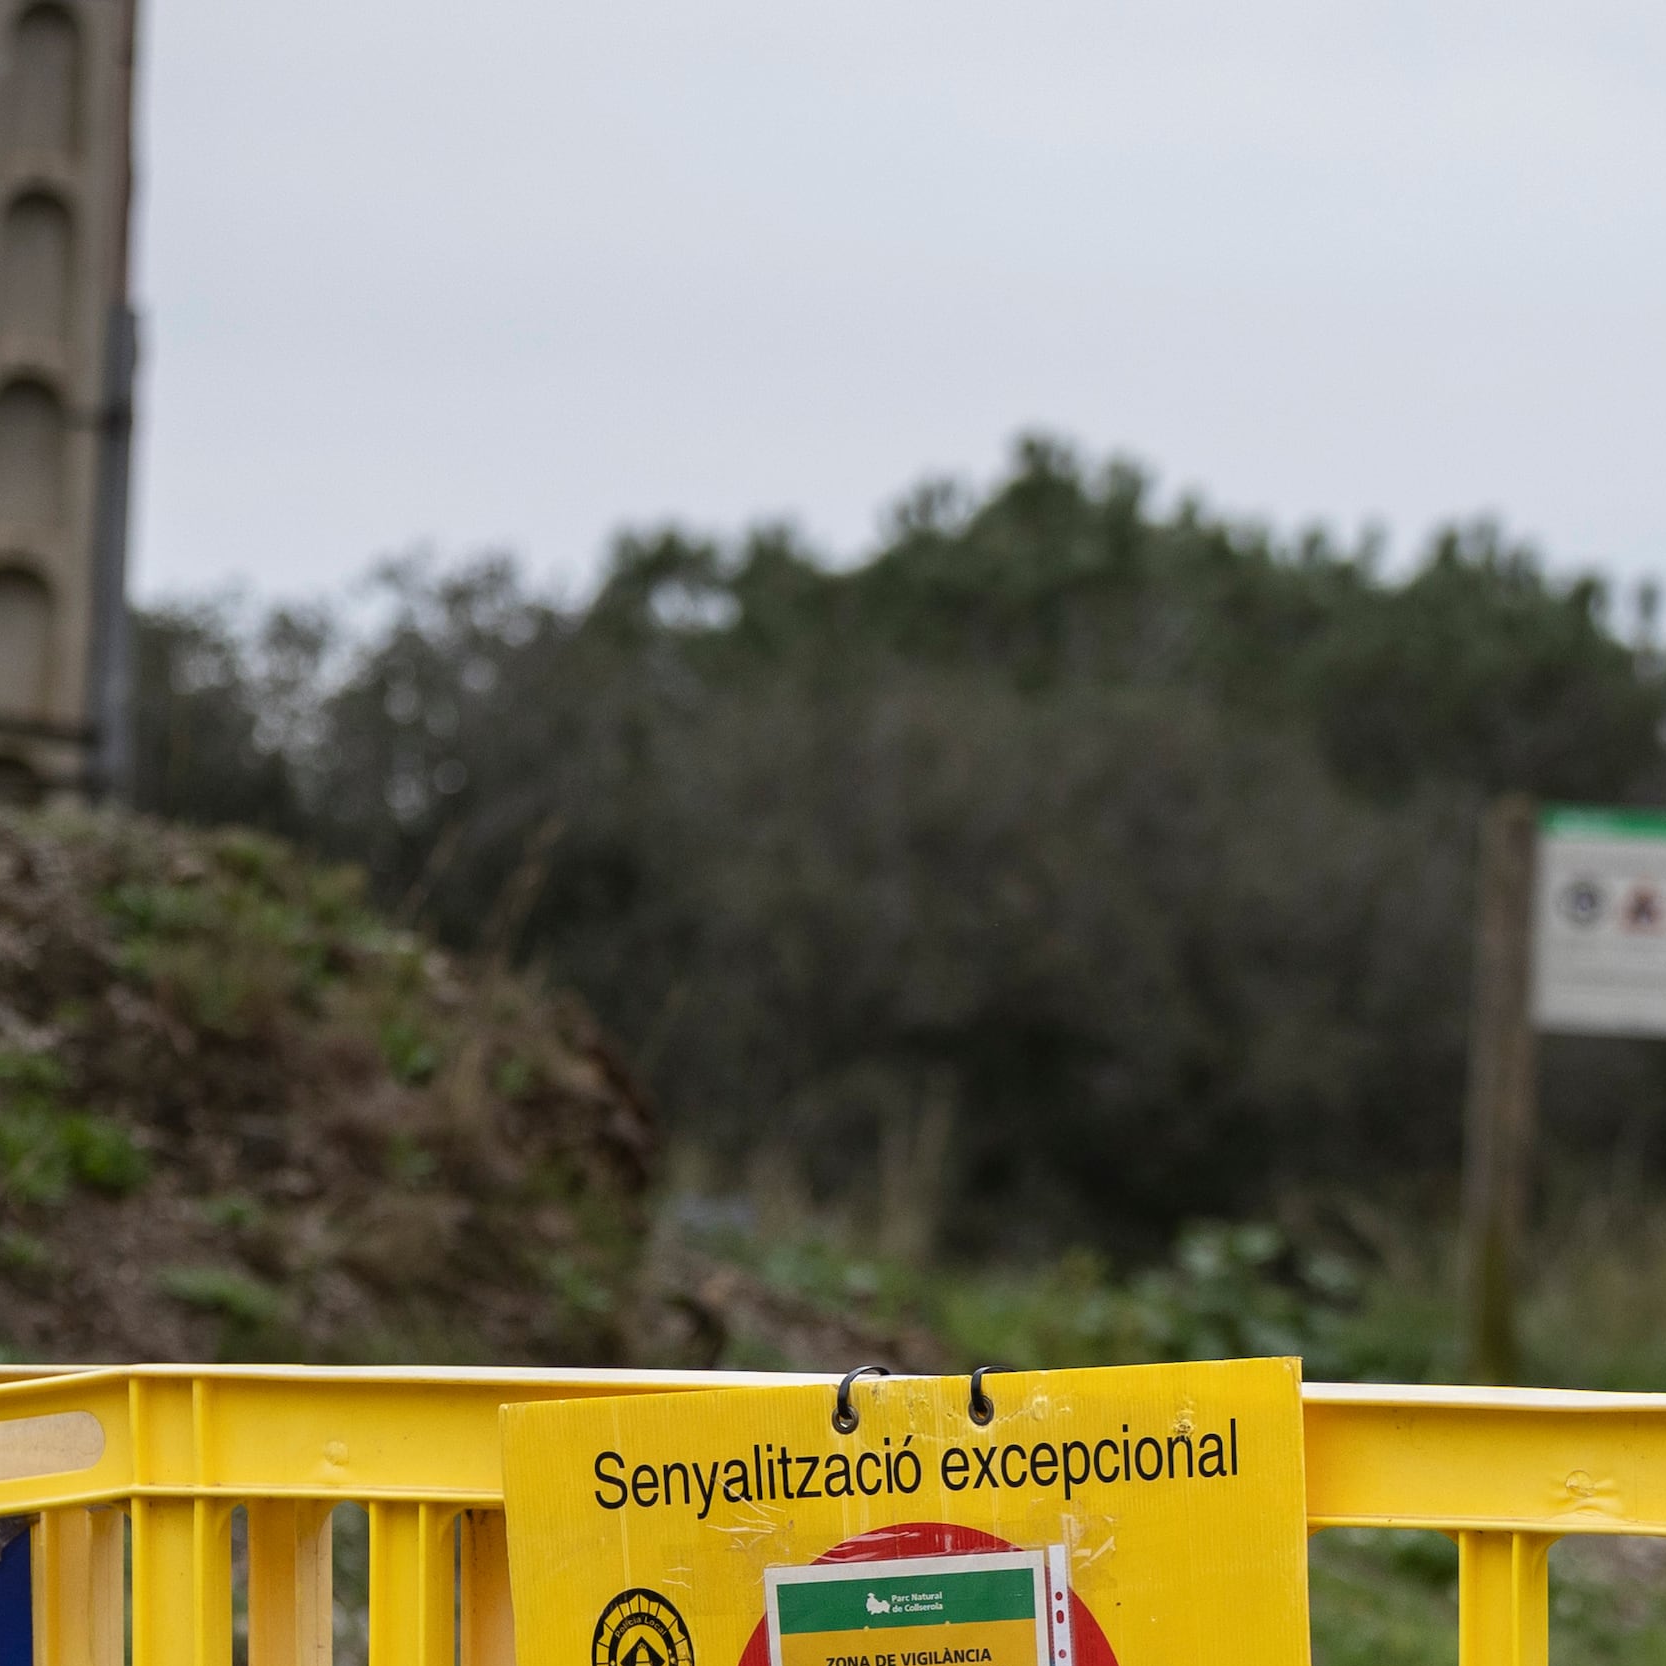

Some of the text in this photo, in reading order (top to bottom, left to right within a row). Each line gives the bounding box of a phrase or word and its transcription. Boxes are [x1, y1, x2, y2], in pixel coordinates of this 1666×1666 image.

[594, 1418, 1239, 1519] Senyalització excepcional
[891, 1591, 943, 1603] Parc Natural
[892, 1605, 903, 1613] de
[644, 1616, 668, 1636] Local
[900, 1648, 992, 1666] VIGILÀNCIA
